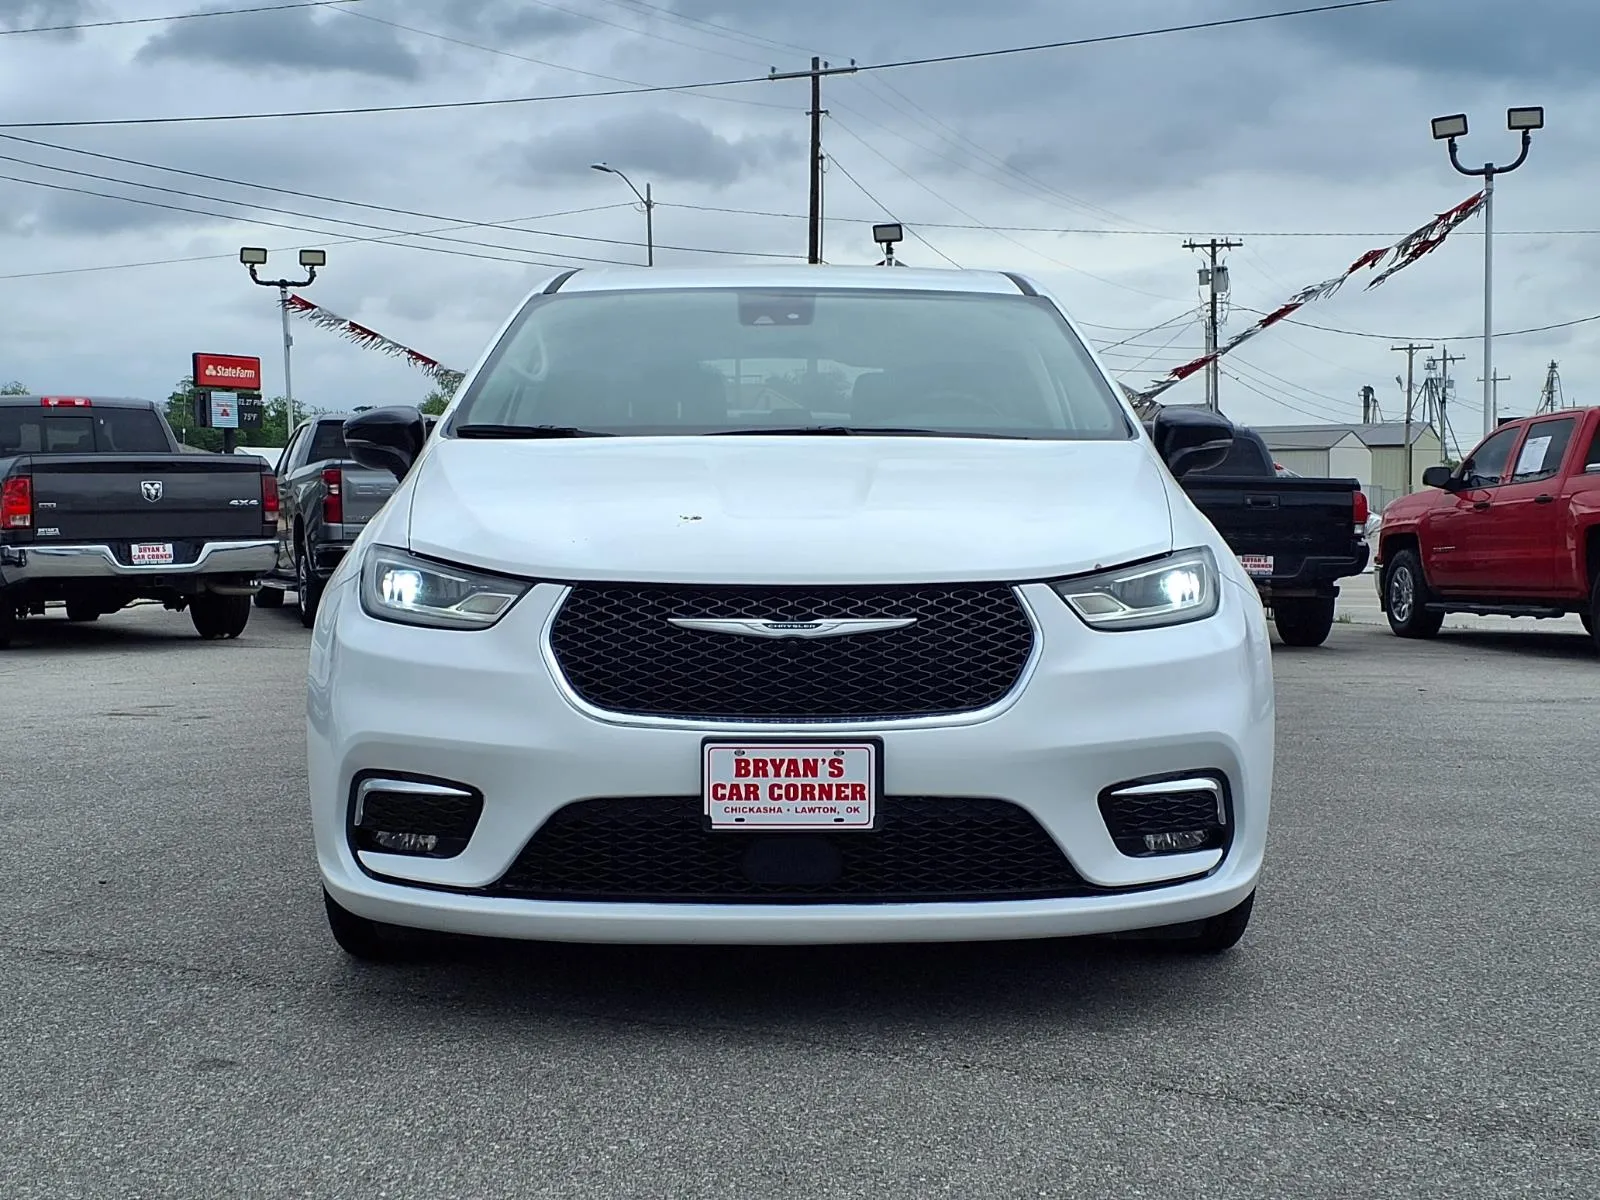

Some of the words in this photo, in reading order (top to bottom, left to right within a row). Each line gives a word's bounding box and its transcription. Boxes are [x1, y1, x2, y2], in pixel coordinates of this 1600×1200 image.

[734, 758, 844, 778] BRYAN'S
[712, 783, 760, 801] CAR
[768, 783, 867, 801] CORNER
[723, 806, 783, 814] CHICKASHA
[794, 806, 840, 815] LAWTON,
[845, 806, 861, 814] OK
